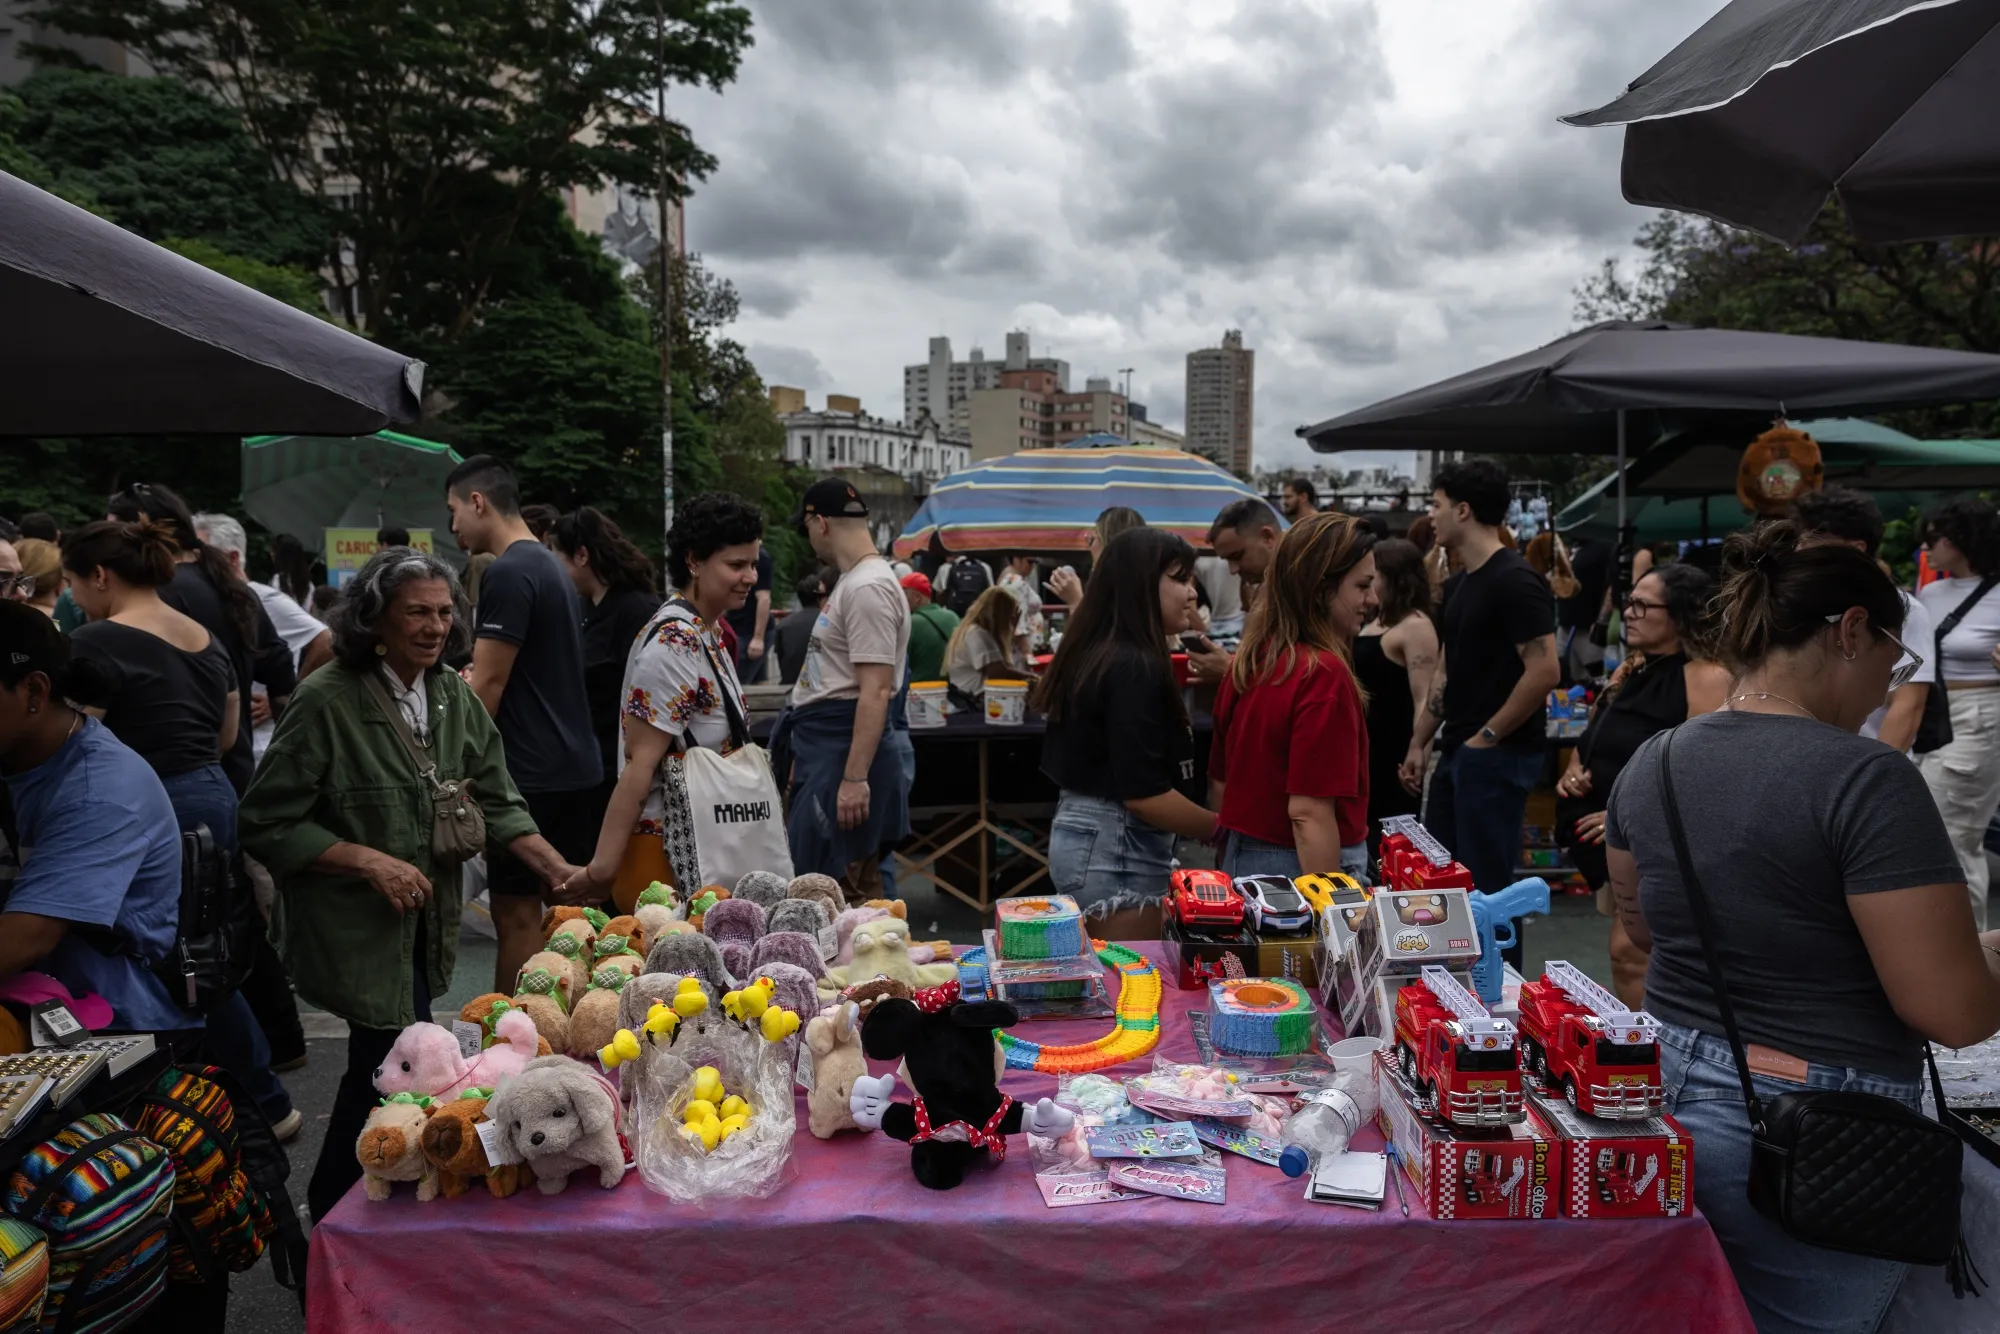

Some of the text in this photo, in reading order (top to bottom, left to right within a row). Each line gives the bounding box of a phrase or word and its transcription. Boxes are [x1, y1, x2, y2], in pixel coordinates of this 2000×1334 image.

[336, 540, 428, 555] CARICAS
[714, 801, 770, 824] MAHKU
[1532, 1143, 1549, 1214] Bombeiro
